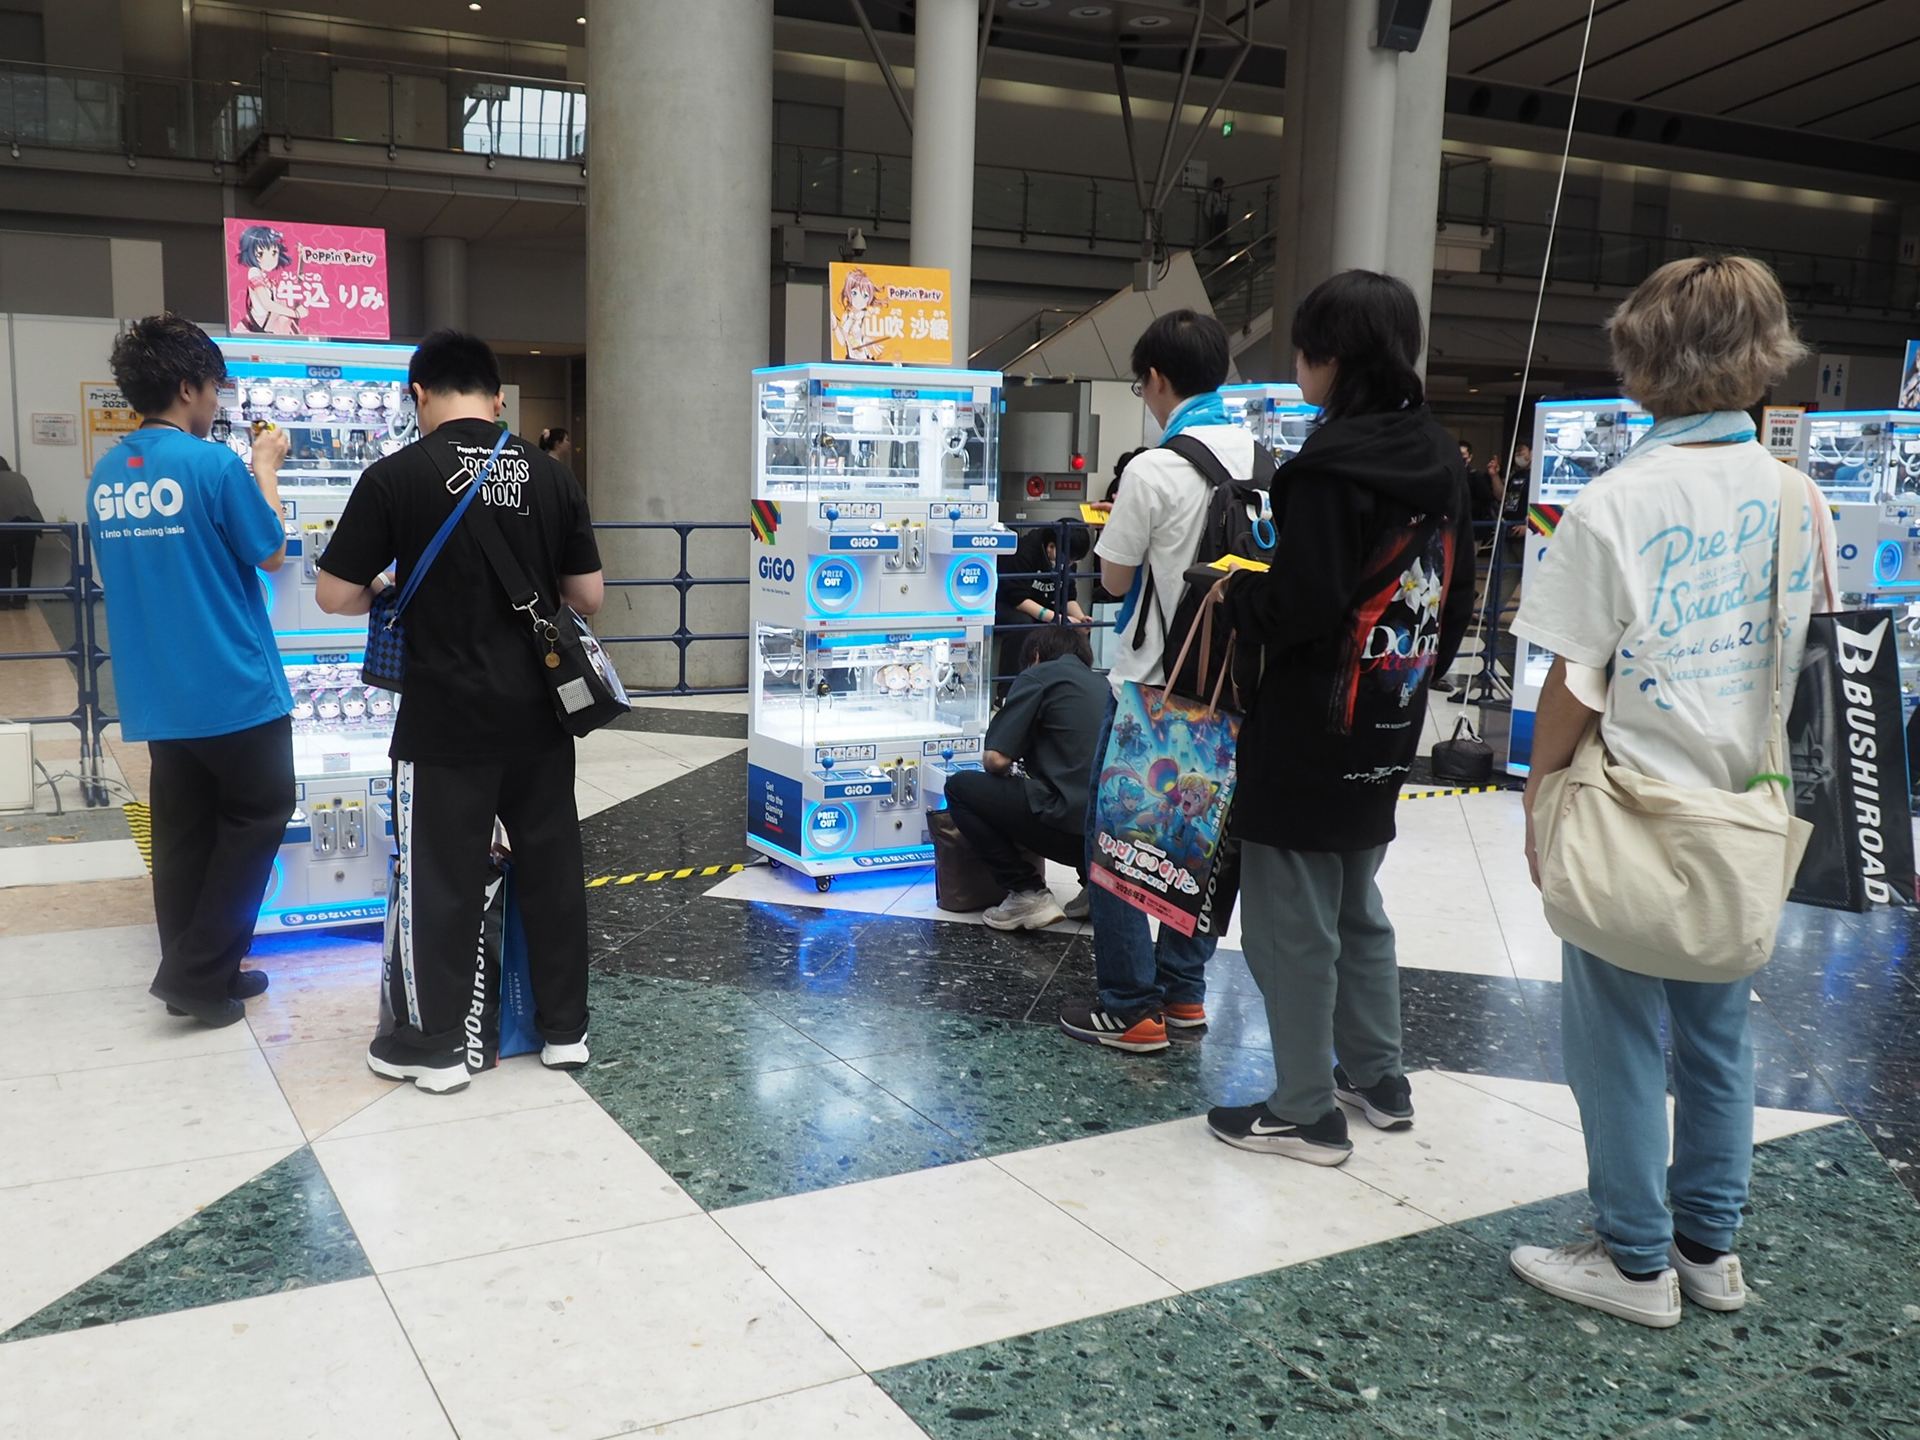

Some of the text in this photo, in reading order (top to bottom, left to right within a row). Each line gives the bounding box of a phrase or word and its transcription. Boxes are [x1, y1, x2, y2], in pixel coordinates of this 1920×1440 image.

[277, 280, 385, 310] 牛込 りみ
[308, 366, 342, 378] GiGO
[90, 392, 126, 400] カードゲー
[93, 477, 184, 521] GiGO
[850, 537, 879, 548] GiGO
[972, 536, 998, 547] GiGO
[759, 556, 794, 582] GiGO
[821, 570, 843, 578] PRIZE
[961, 569, 981, 577] PRIZE
[823, 578, 841, 587] OUT
[963, 576, 978, 585] OUT
[1659, 573, 1748, 637] Sound
[844, 785, 873, 796] GiGO
[1842, 678, 1890, 904] BUSHIROAD
[817, 811, 839, 820] PRIZE
[820, 820, 837, 828] OUT
